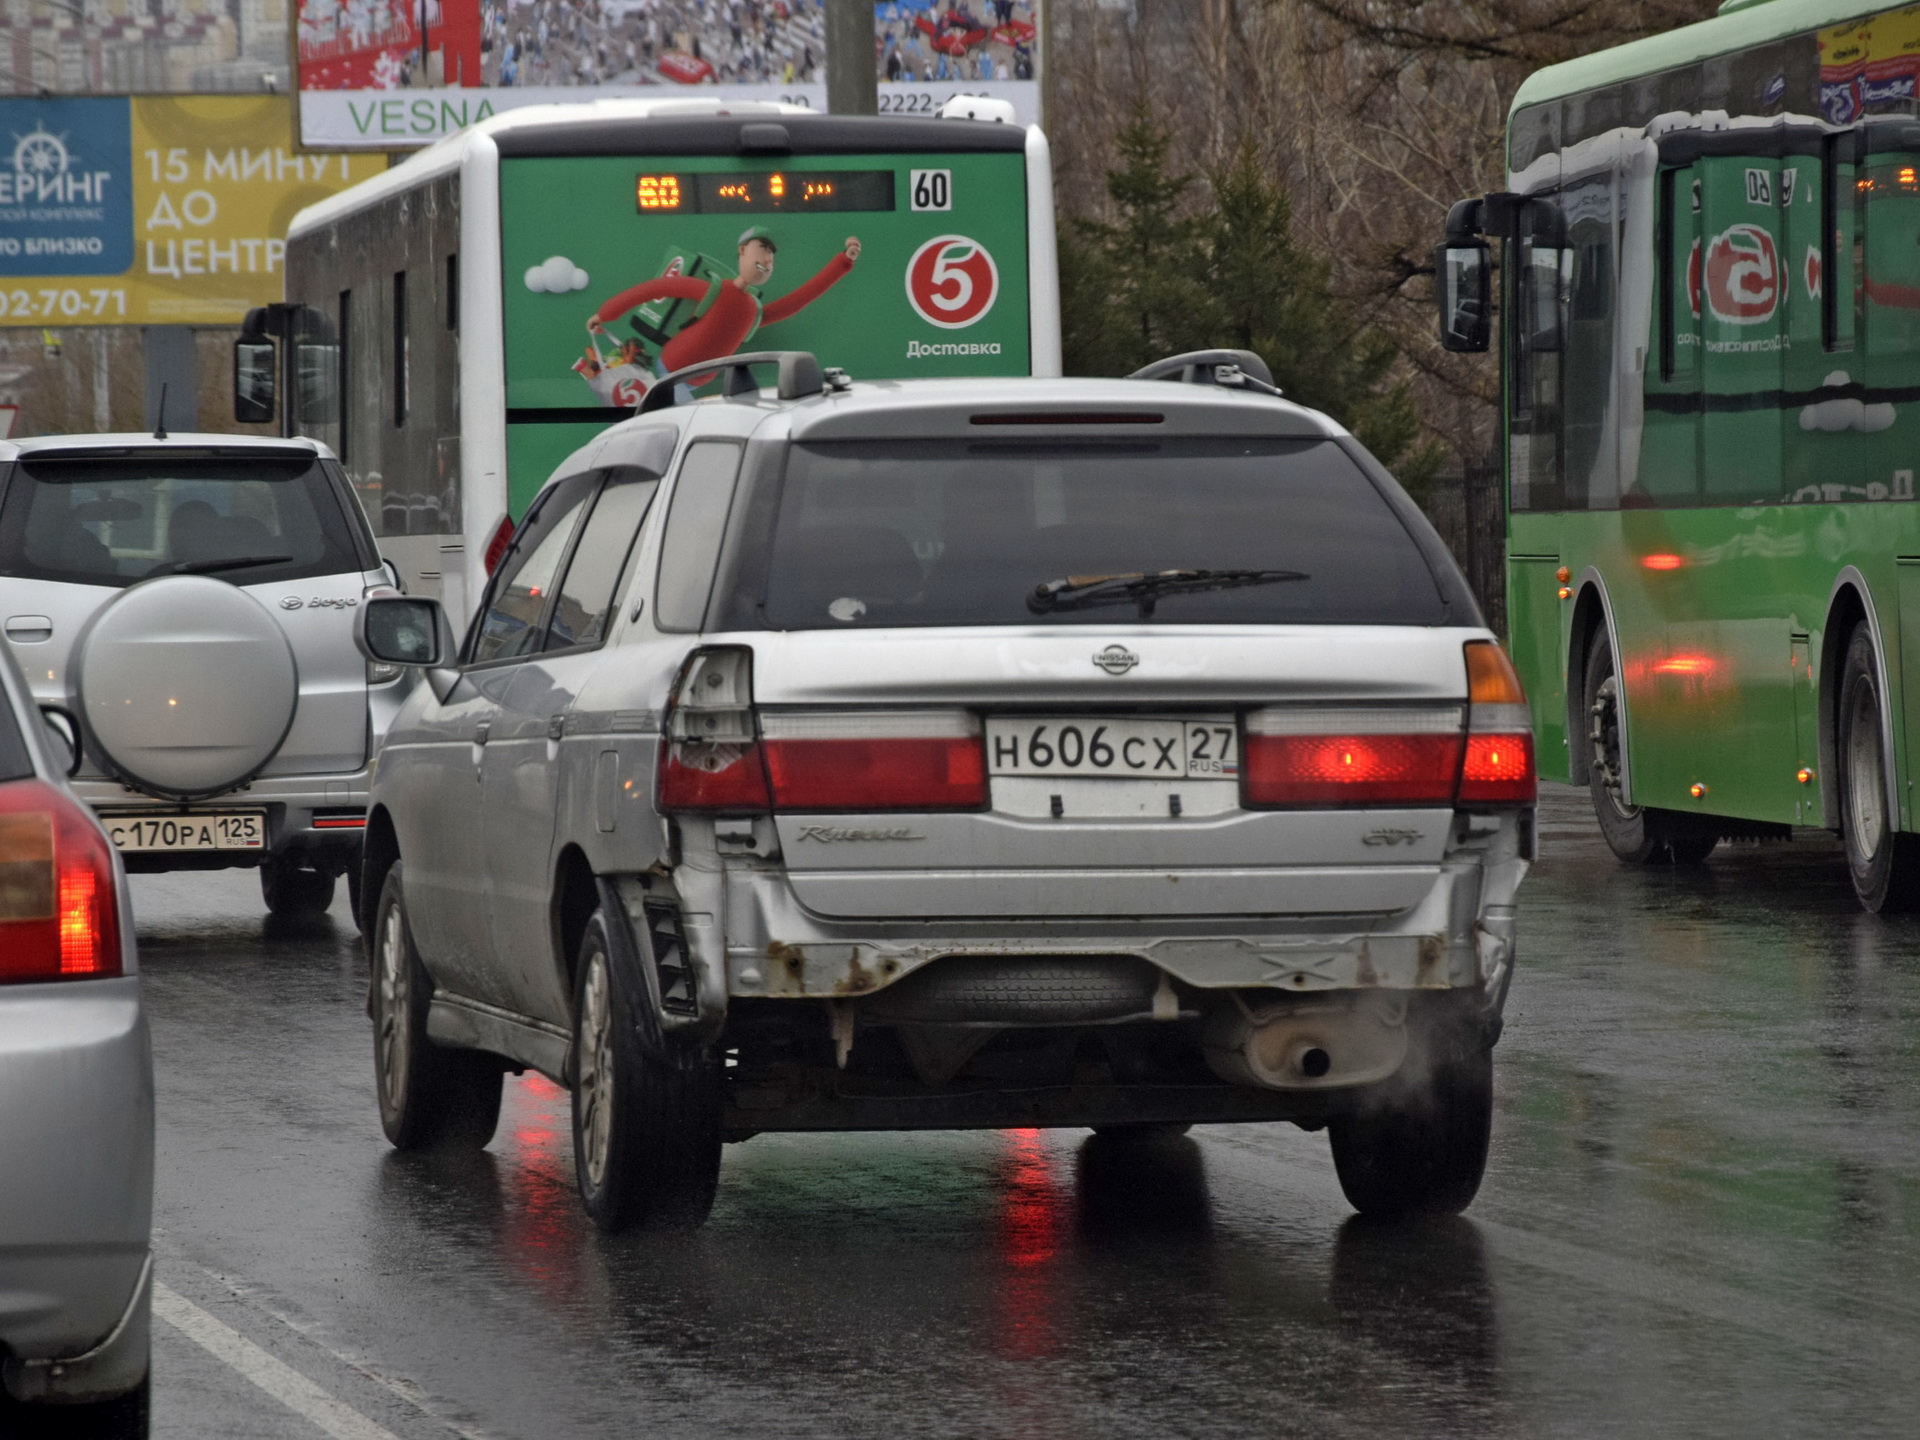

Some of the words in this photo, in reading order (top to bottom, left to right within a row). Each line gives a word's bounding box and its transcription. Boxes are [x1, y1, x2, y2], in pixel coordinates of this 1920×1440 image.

[348, 98, 495, 134] VESNA
[879, 93, 990, 112] 2222-
[145, 148, 189, 182] 15
[203, 148, 350, 181] МИНУТ
[639, 177, 679, 206] 60
[914, 172, 947, 208] 60
[146, 190, 217, 230] ДО
[24, 237, 103, 254] БЛИЗКО
[930, 242, 978, 311] 5
[906, 341, 1001, 358] Доставка
[994, 725, 1178, 771] Н606СХ
[1190, 728, 1233, 760] 27
[1189, 760, 1222, 773] RUS
[110, 821, 213, 847] С170РА
[217, 817, 257, 838] 125
[226, 838, 246, 846] RUS
